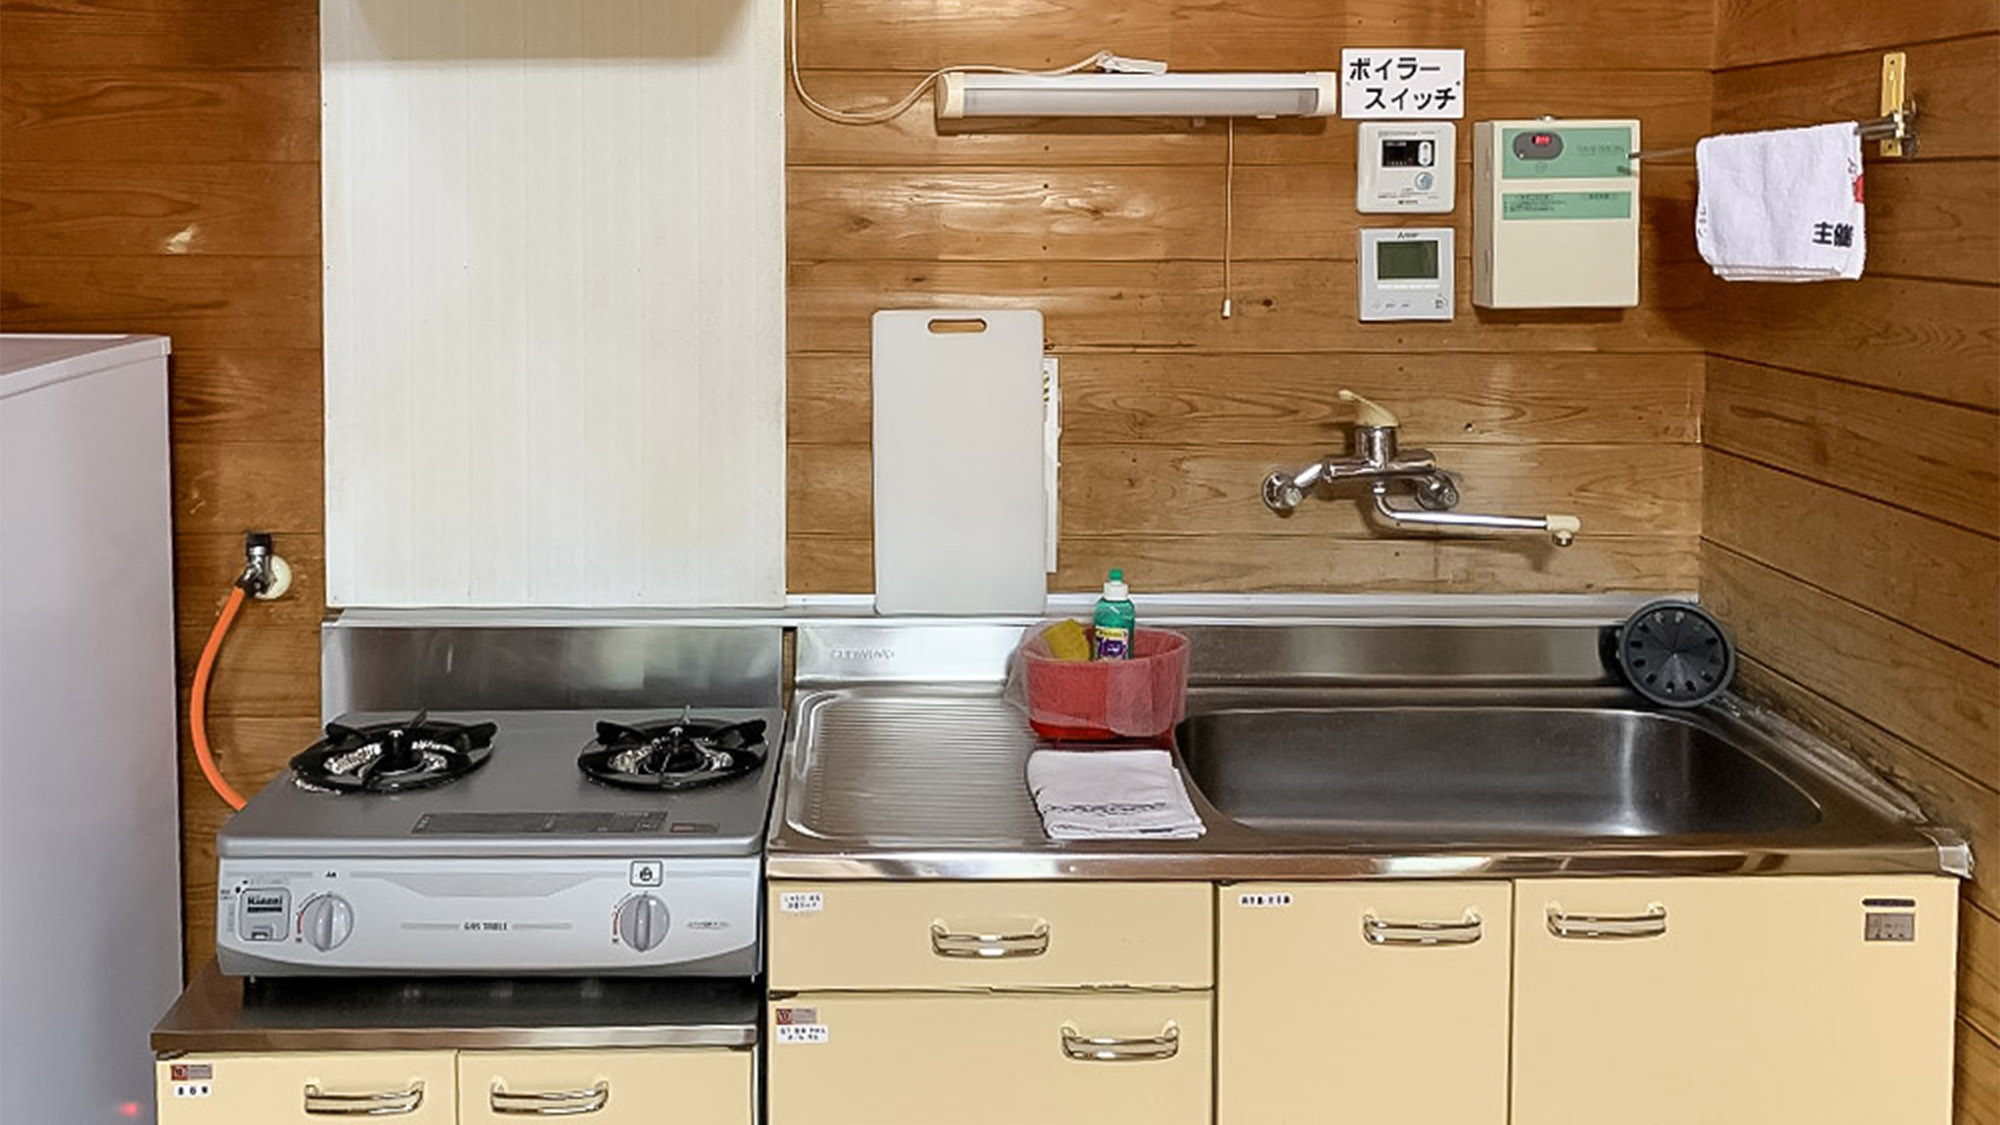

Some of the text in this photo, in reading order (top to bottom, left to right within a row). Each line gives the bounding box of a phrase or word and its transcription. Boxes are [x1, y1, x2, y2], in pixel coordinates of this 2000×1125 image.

[1349, 57, 1441, 80] ボイラー
[1364, 87, 1456, 111] スイッチ
